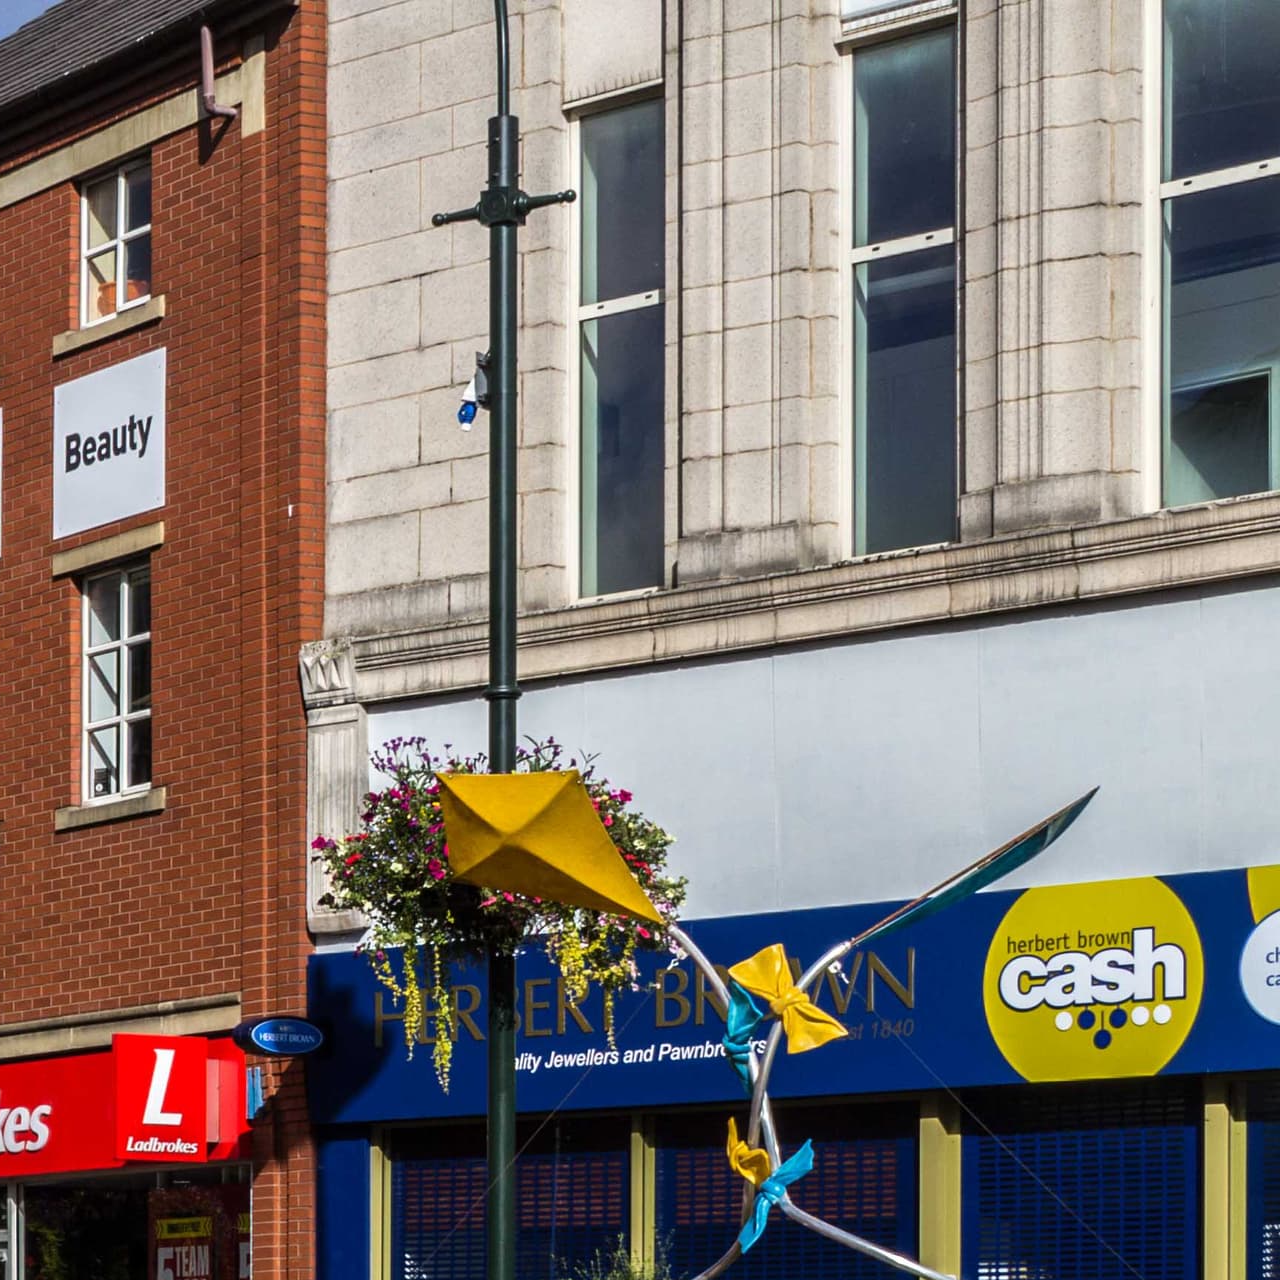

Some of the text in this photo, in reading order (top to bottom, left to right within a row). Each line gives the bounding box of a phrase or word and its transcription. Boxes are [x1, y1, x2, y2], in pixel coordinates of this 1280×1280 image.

[65, 415, 153, 473] Beauty
[1007, 930, 1131, 954] herbert brown
[998, 927, 1187, 1013] cash
[655, 948, 915, 1028] BRWN
[871, 1019, 914, 1039] 1840
[545, 1048, 619, 1070] Jewellers
[622, 1044, 653, 1063] and
[658, 1036, 767, 1061] Pawnbrrs
[142, 1048, 183, 1126] L
[126, 1136, 199, 1154] Ladbrokes
[175, 1245, 209, 1277] TEAM
